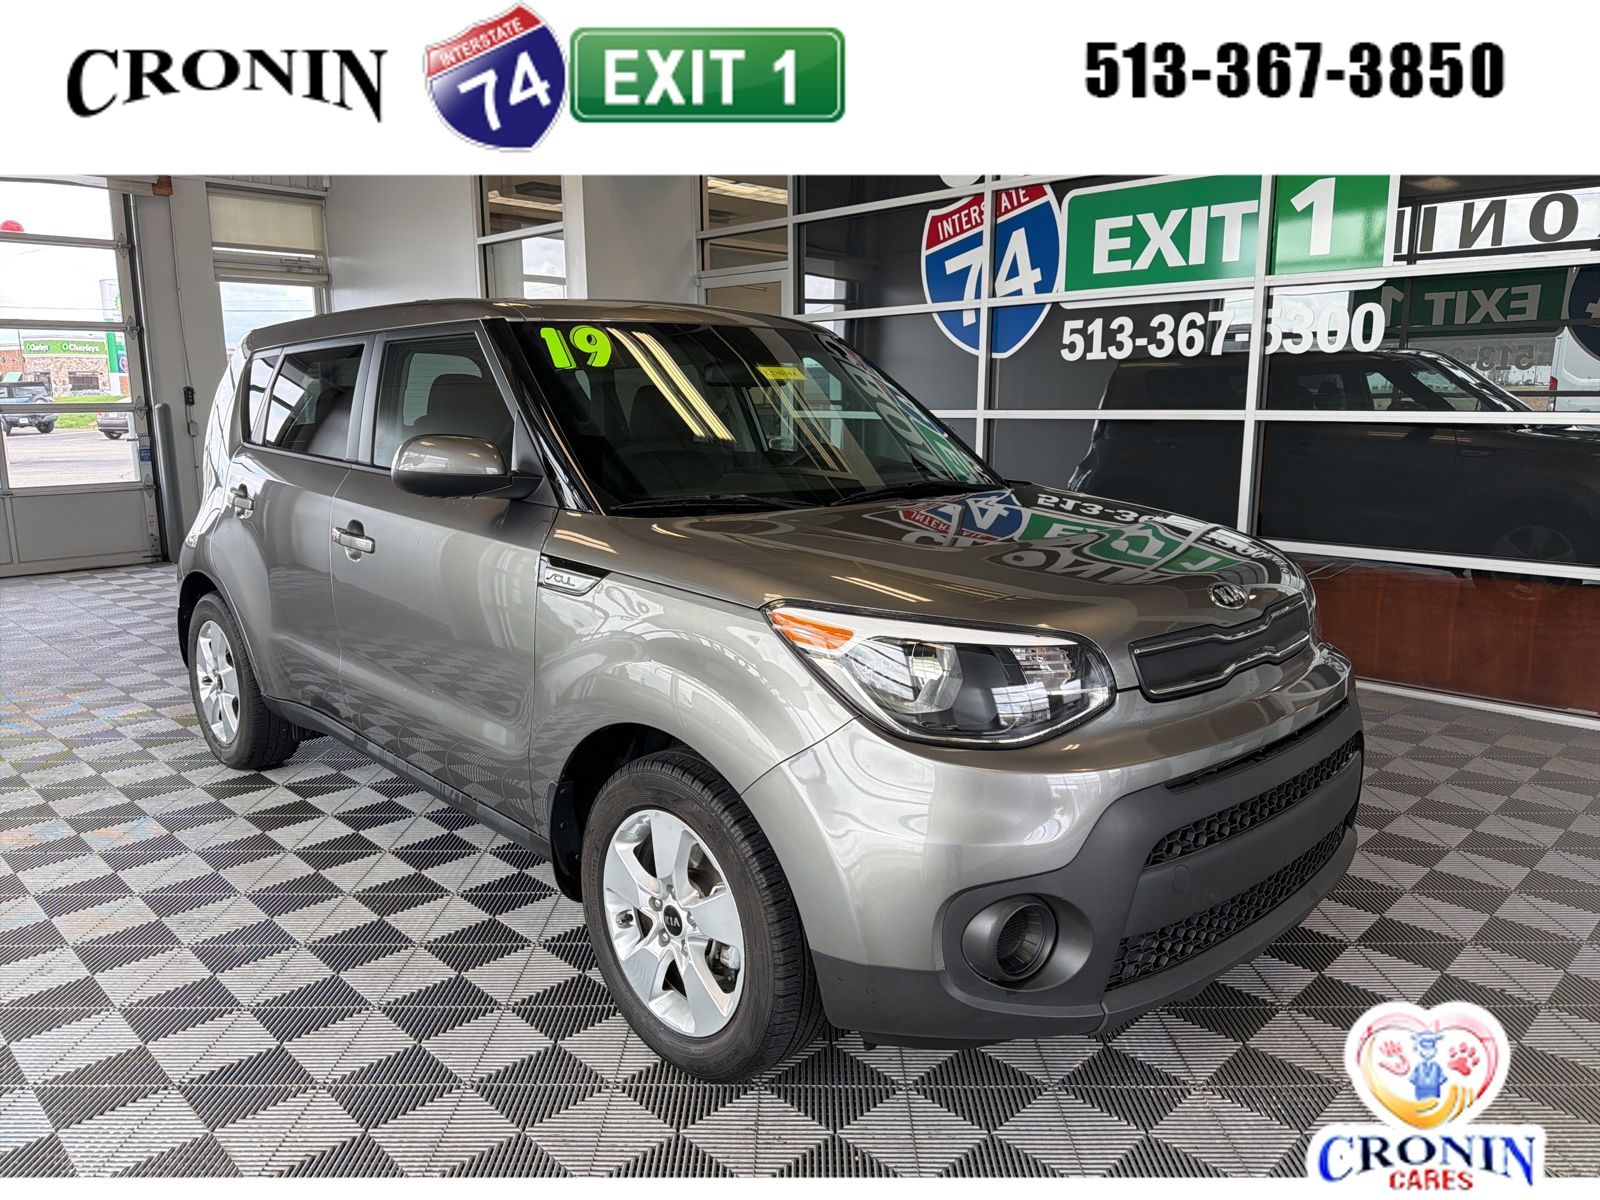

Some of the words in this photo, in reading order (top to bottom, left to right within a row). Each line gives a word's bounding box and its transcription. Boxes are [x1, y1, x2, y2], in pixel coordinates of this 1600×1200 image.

[937, 187, 1030, 240] INTERSATE
[1093, 199, 1259, 275] EXIT
[1290, 177, 1336, 257] 1
[944, 227, 1042, 327] 74
[540, 325, 613, 372] 19
[1060, 302, 1386, 362] 513-367-5300
[664, 915, 681, 928] KIA
